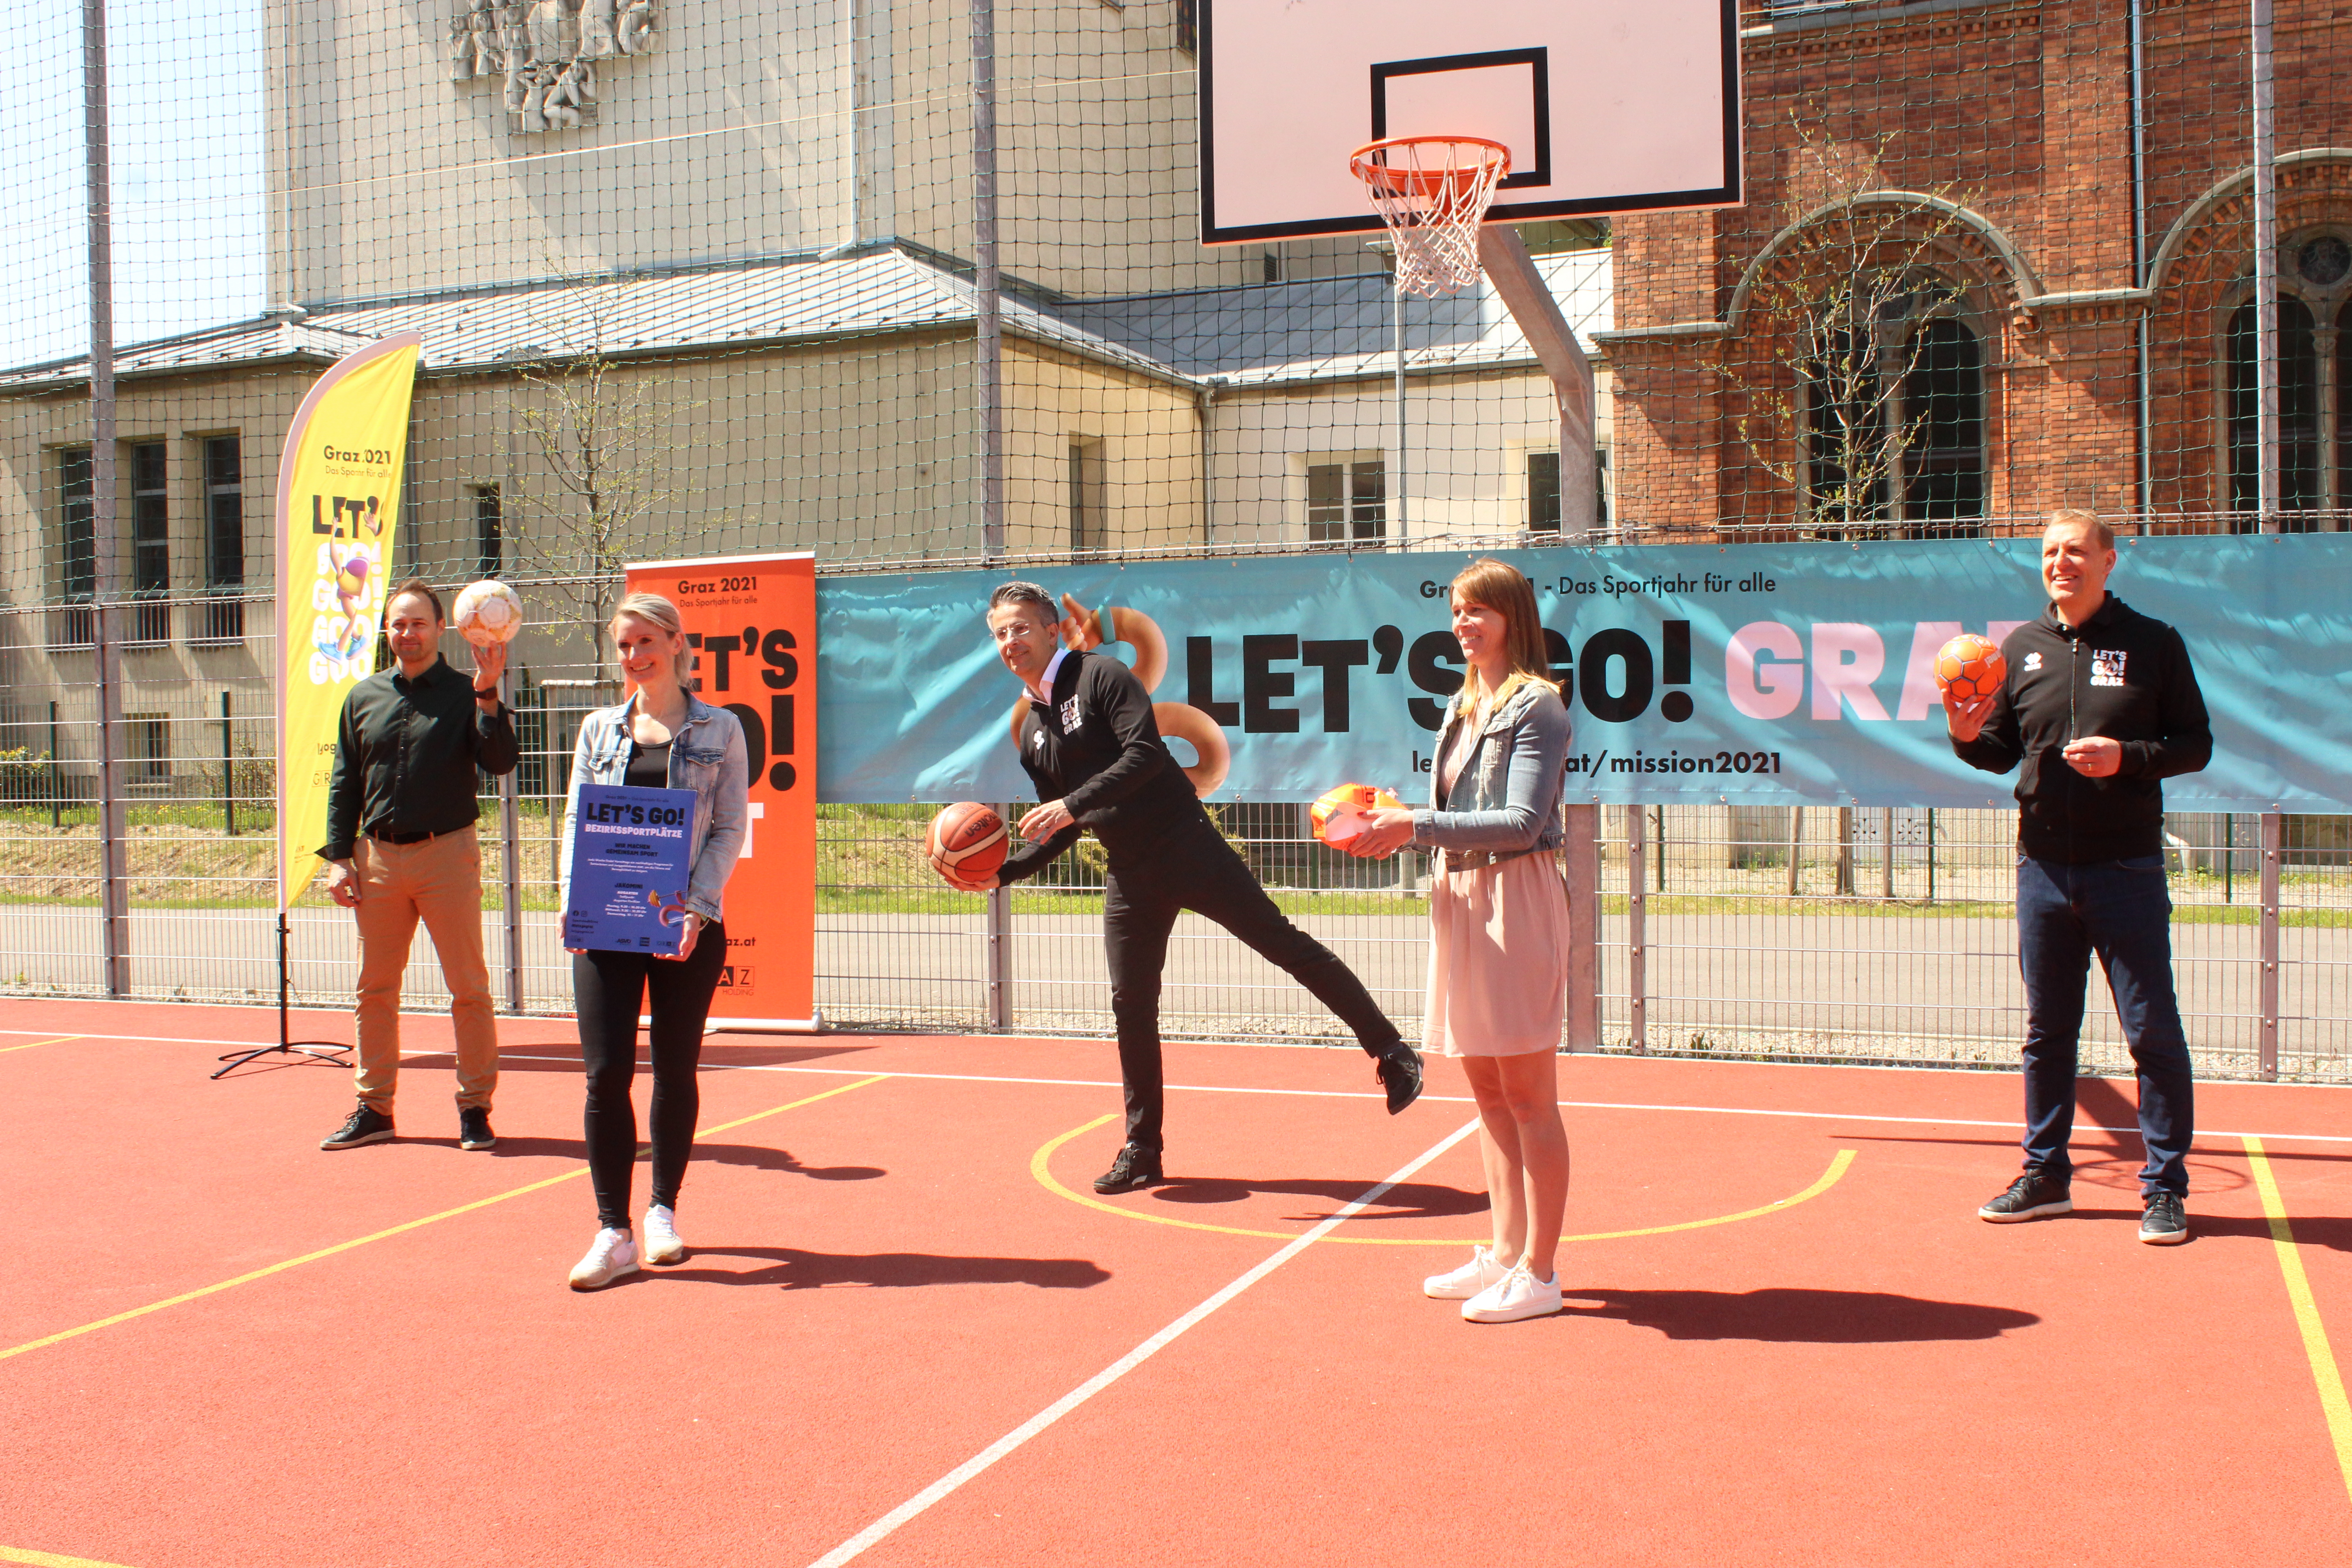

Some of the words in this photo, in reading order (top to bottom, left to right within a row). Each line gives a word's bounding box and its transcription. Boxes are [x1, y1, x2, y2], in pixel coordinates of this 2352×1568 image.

[323, 445, 360, 462] Graz
[325, 466, 339, 475] Das
[367, 468, 376, 477] für
[377, 469, 391, 479] alle
[678, 580, 716, 594] Graz
[720, 577, 757, 592] 2021
[1559, 577, 1596, 595] Das
[1603, 575, 1698, 599] Sportjahr
[1704, 573, 1732, 593] für
[1739, 572, 1776, 592] alle
[696, 596, 730, 608] Sportjahr
[732, 596, 742, 604] für
[744, 595, 758, 604] alle
[2092, 649, 2127, 661] LET'S
[2091, 660, 2125, 676] GO!
[1187, 625, 1466, 733] LET'S
[2090, 676, 2124, 686] GRAZ
[1063, 717, 1083, 735] GRAZ
[587, 803, 644, 824] LET'S
[648, 807, 685, 826] GO!
[585, 823, 683, 838] BEZIRKSSPORTPLÄTZE
[965, 812, 997, 837] molten
